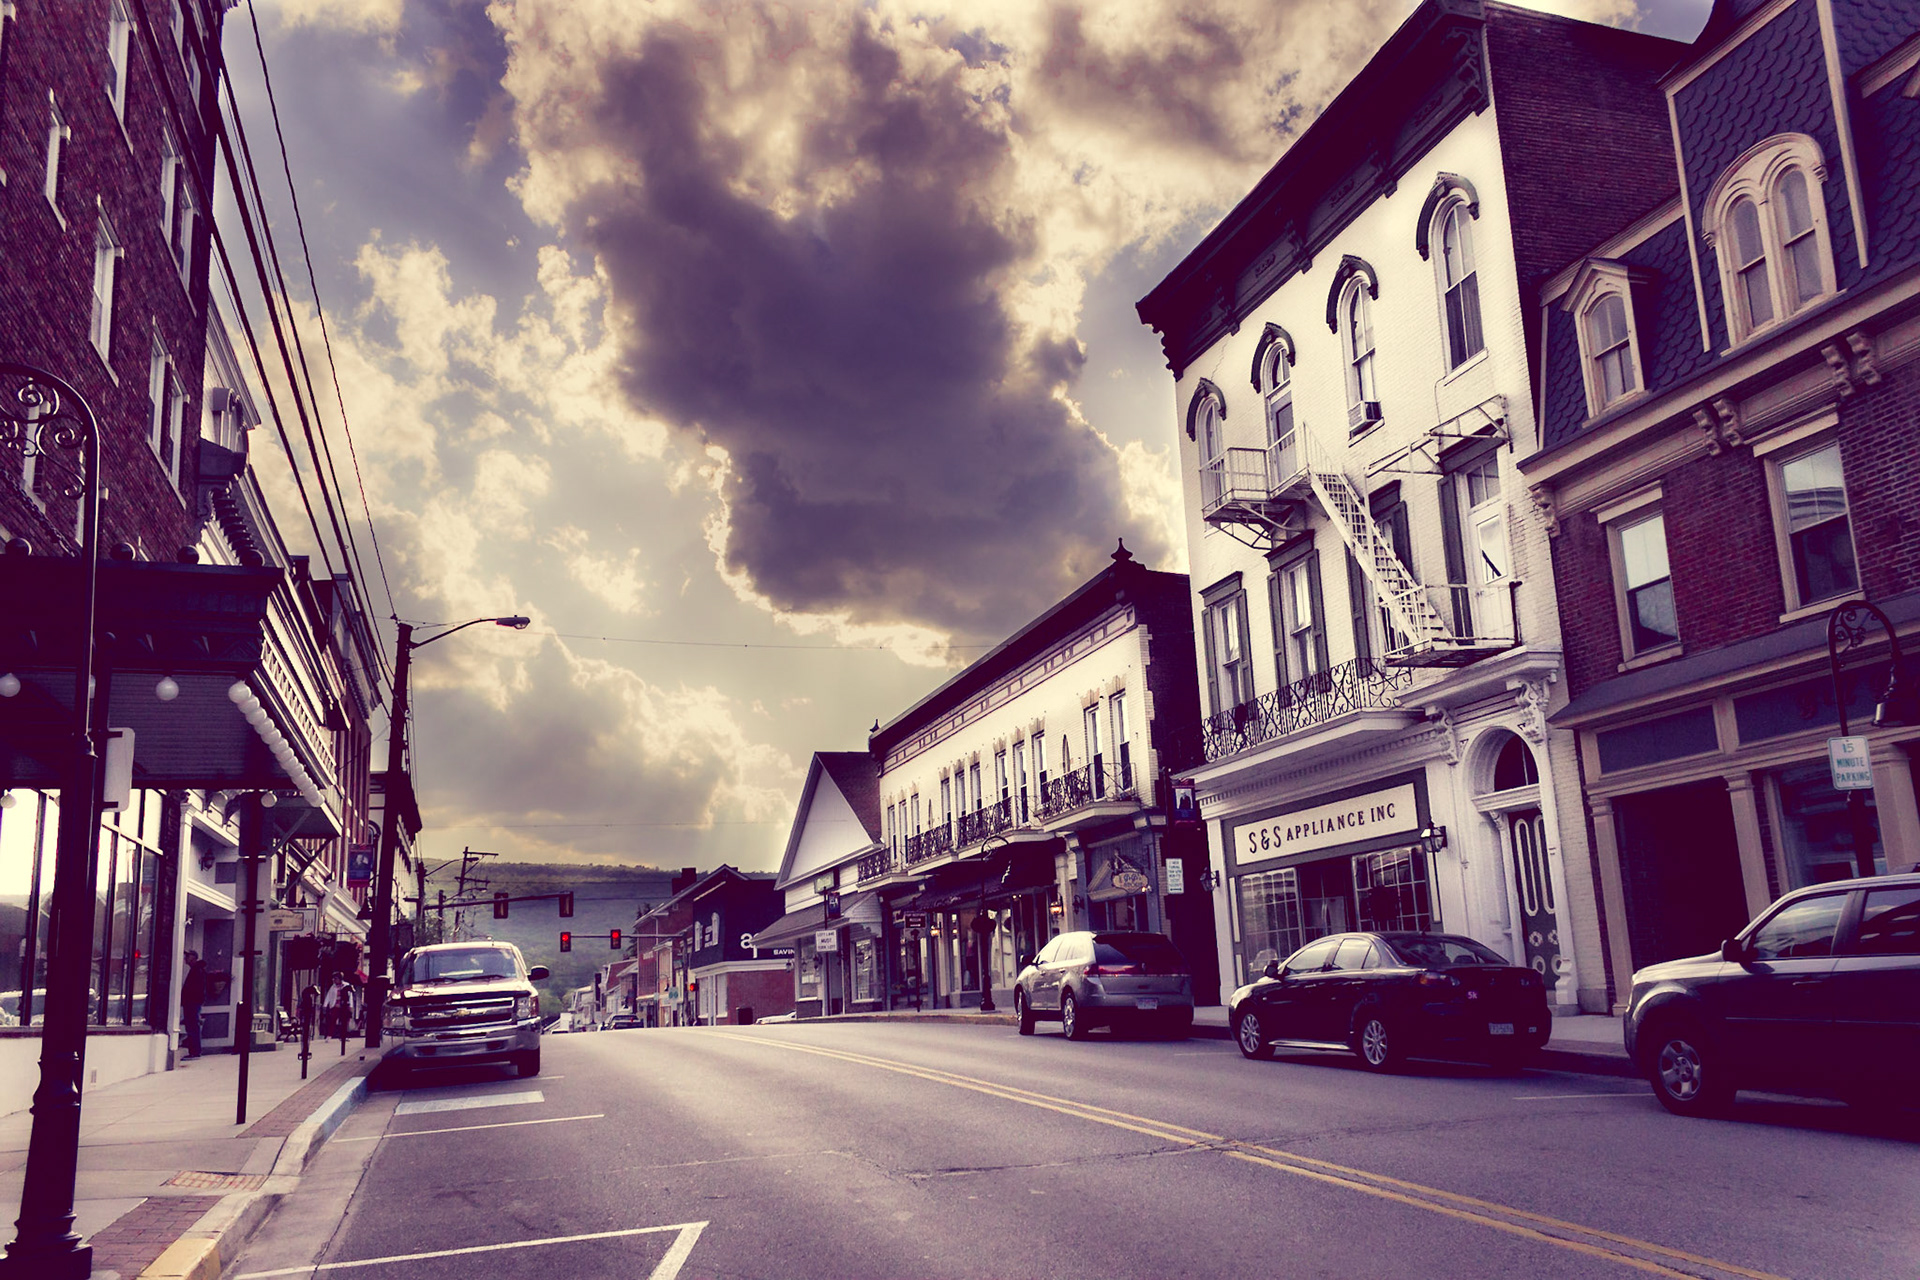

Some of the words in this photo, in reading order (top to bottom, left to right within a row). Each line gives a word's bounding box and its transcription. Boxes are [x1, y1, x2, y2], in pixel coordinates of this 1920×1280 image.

[1842, 743, 1854, 753] 15
[1837, 757, 1865, 768] MINUTE
[1836, 771, 1870, 782] PARKING
[1249, 826, 1281, 853] S&S
[1286, 811, 1365, 841] APPLIANCE
[1371, 803, 1395, 823] INC
